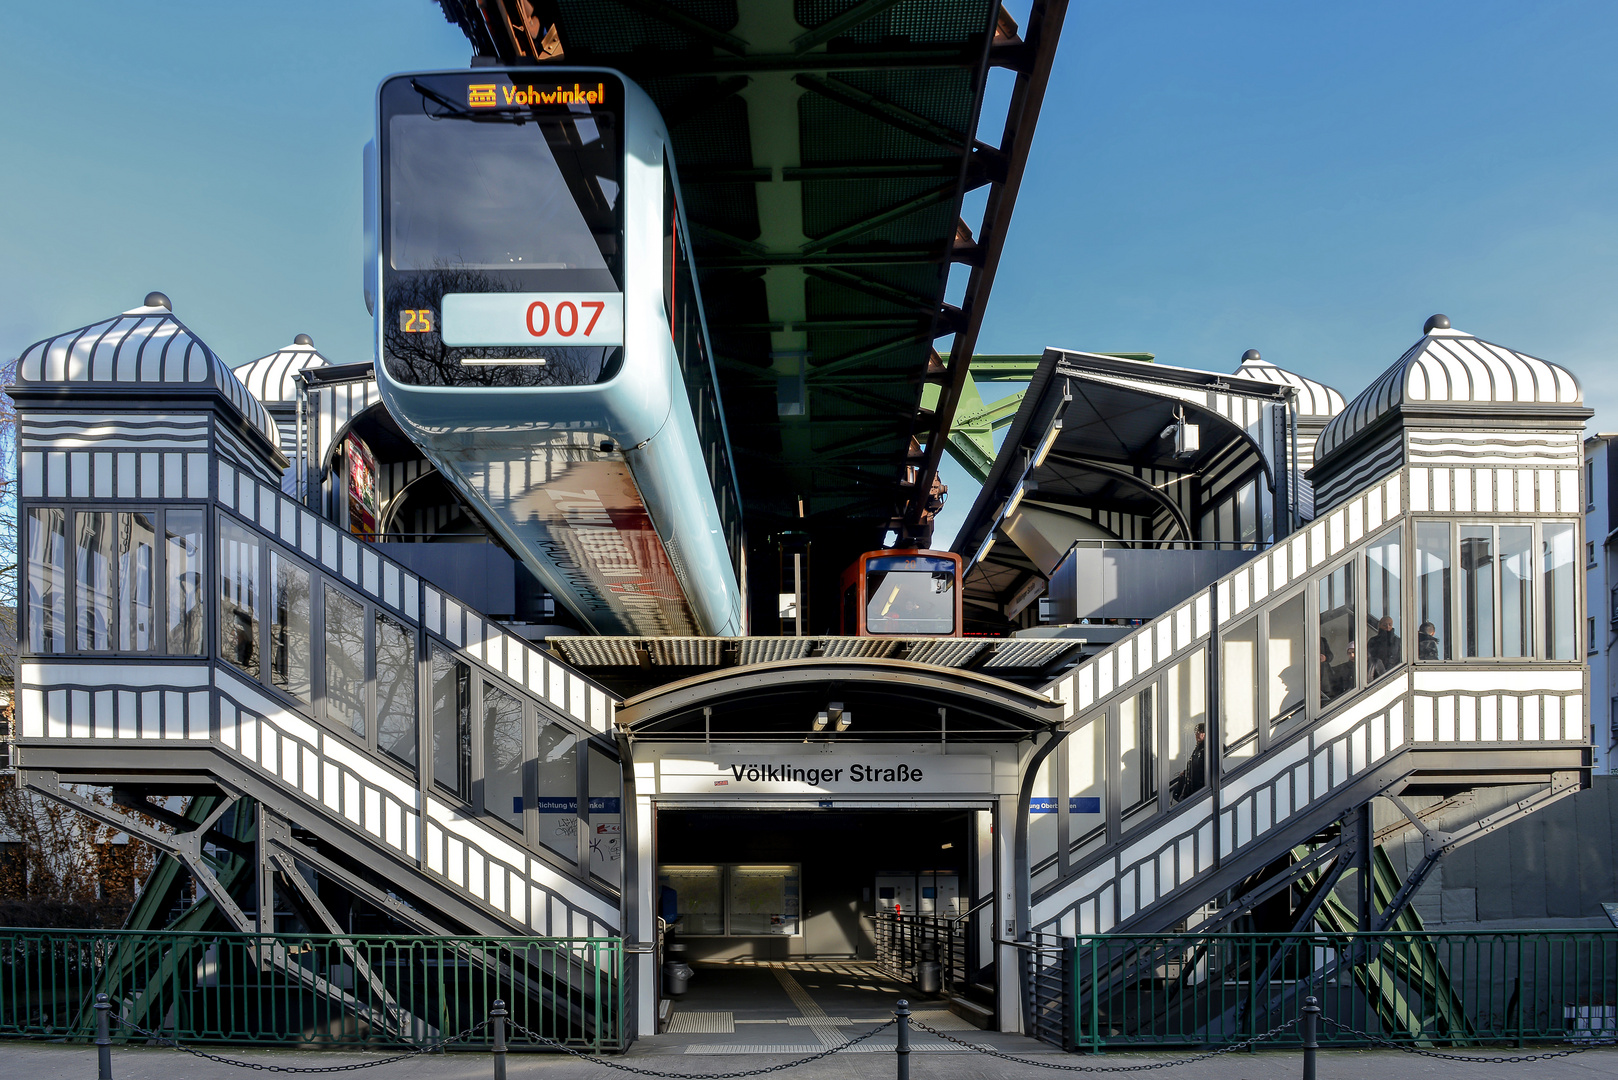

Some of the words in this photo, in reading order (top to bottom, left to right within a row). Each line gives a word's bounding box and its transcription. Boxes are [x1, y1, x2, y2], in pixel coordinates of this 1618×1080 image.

[502, 83, 604, 105] Vohwinkel
[405, 309, 431, 333] 25
[526, 301, 605, 337] 007
[545, 489, 633, 560] ZUHAUSE
[597, 563, 642, 577] IN
[536, 540, 582, 569] RADIO
[904, 559, 916, 570] 20
[731, 763, 843, 786] Völklinger
[849, 764, 923, 782] Straße
